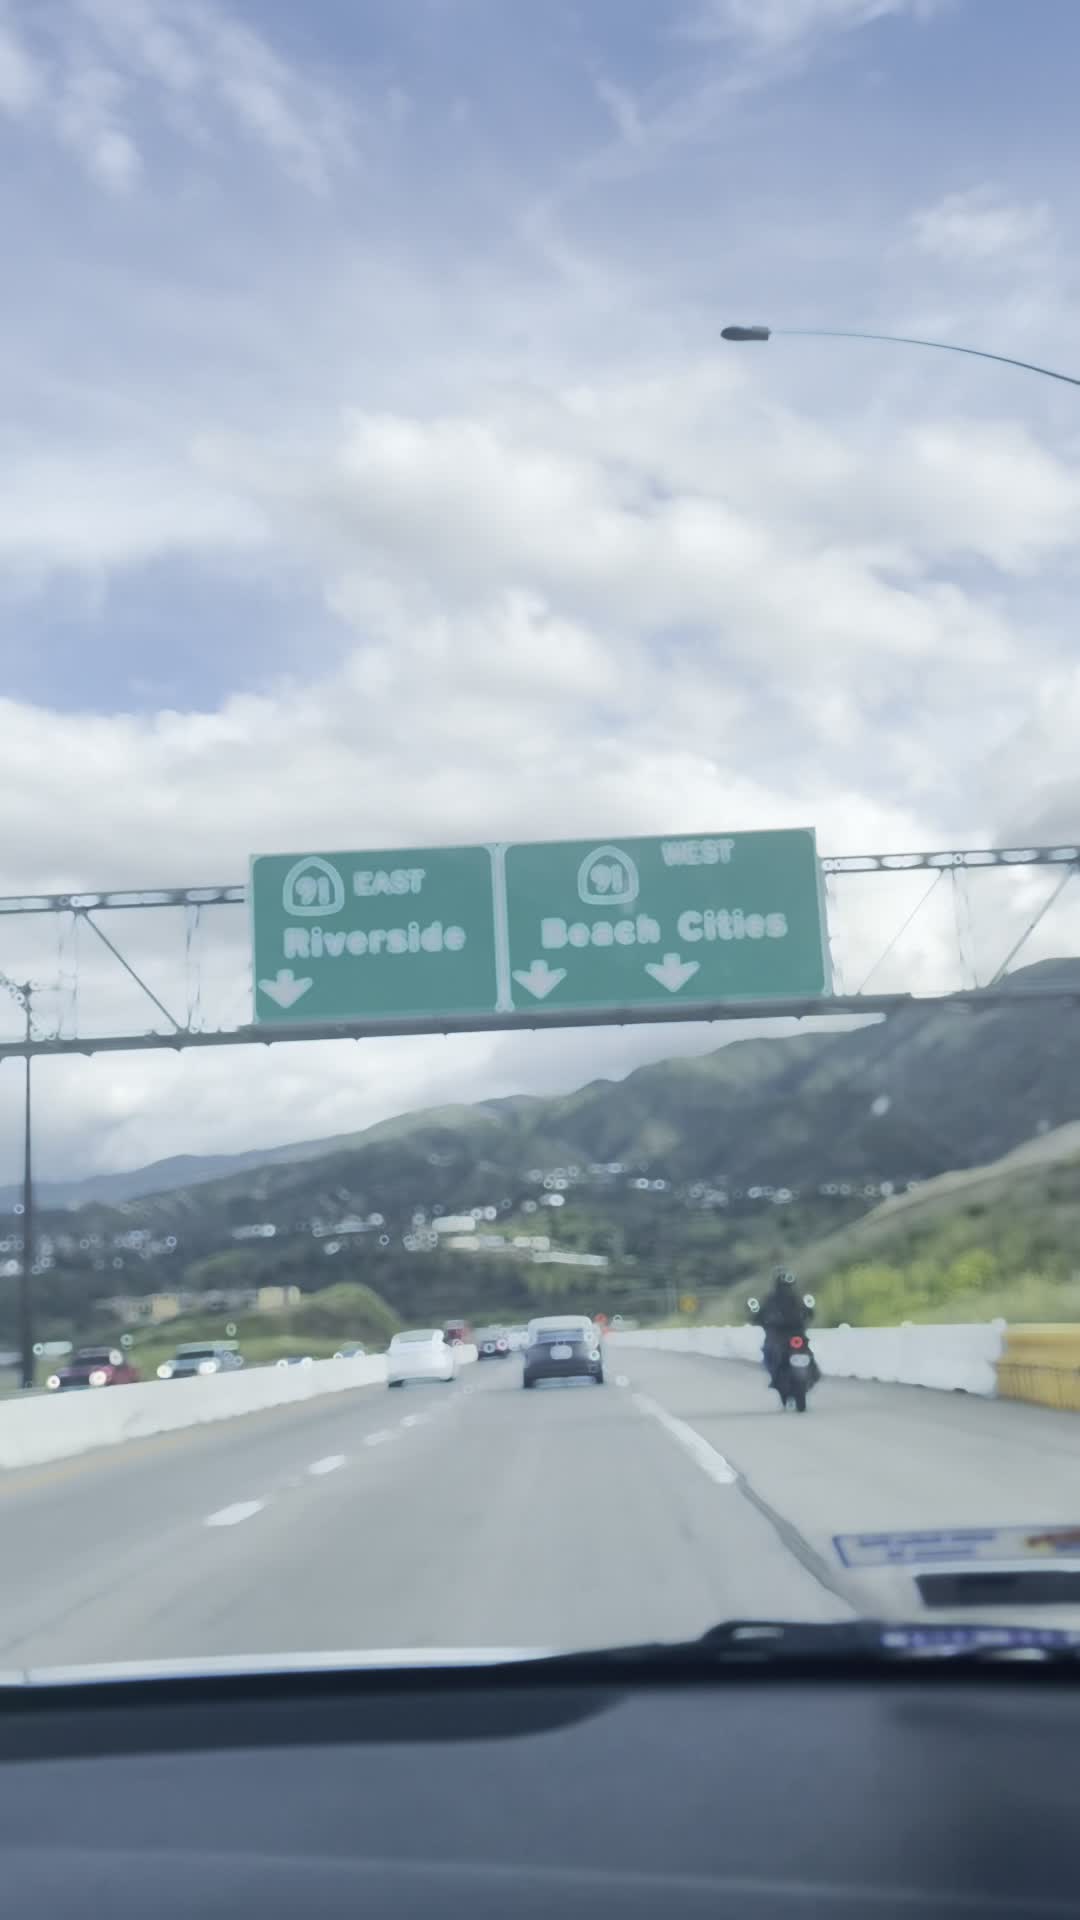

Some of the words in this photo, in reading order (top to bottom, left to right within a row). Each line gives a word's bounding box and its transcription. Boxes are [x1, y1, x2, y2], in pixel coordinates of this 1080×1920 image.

[661, 839, 735, 866] WEST
[353, 868, 426, 896] EAST
[283, 920, 466, 959] Riverside
[541, 913, 661, 949] Beach
[677, 908, 788, 942] Cities
